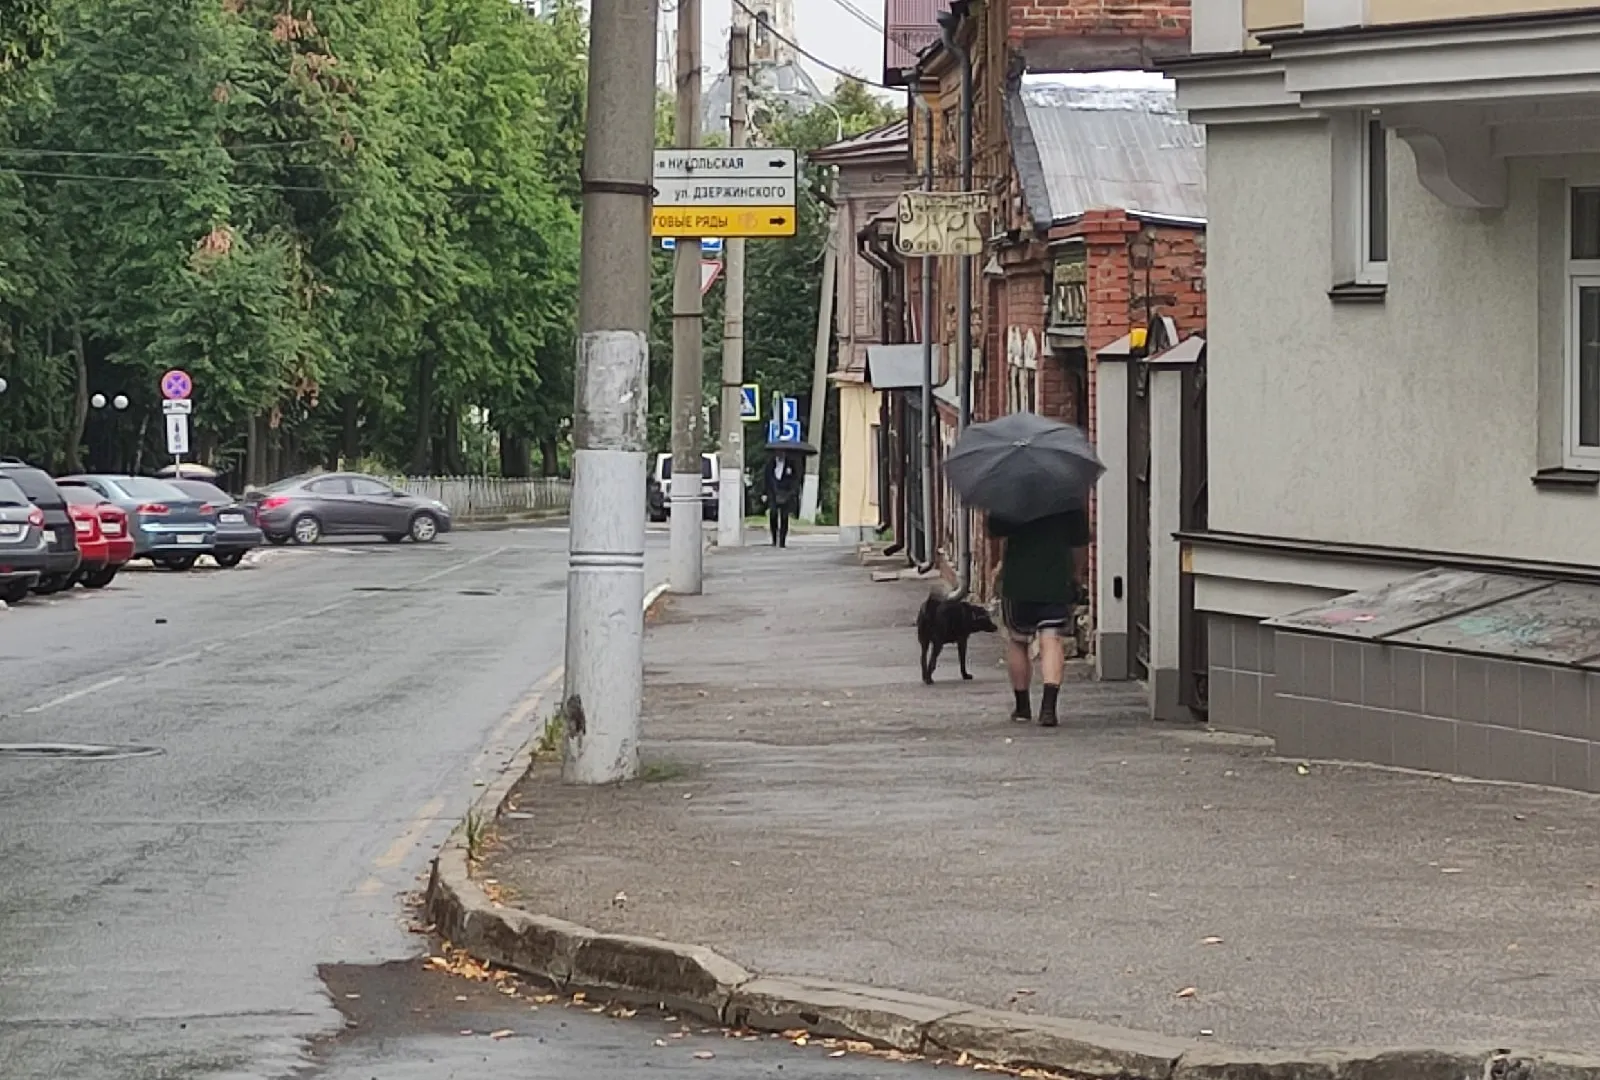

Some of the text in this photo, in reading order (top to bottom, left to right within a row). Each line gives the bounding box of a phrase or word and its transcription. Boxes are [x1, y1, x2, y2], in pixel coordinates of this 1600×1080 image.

[668, 157, 744, 170] НИКОЛЬСКАЯ
[693, 186, 786, 200] ДЗЕРЖИНСКОГО
[695, 215, 729, 228] РЯДЫ
